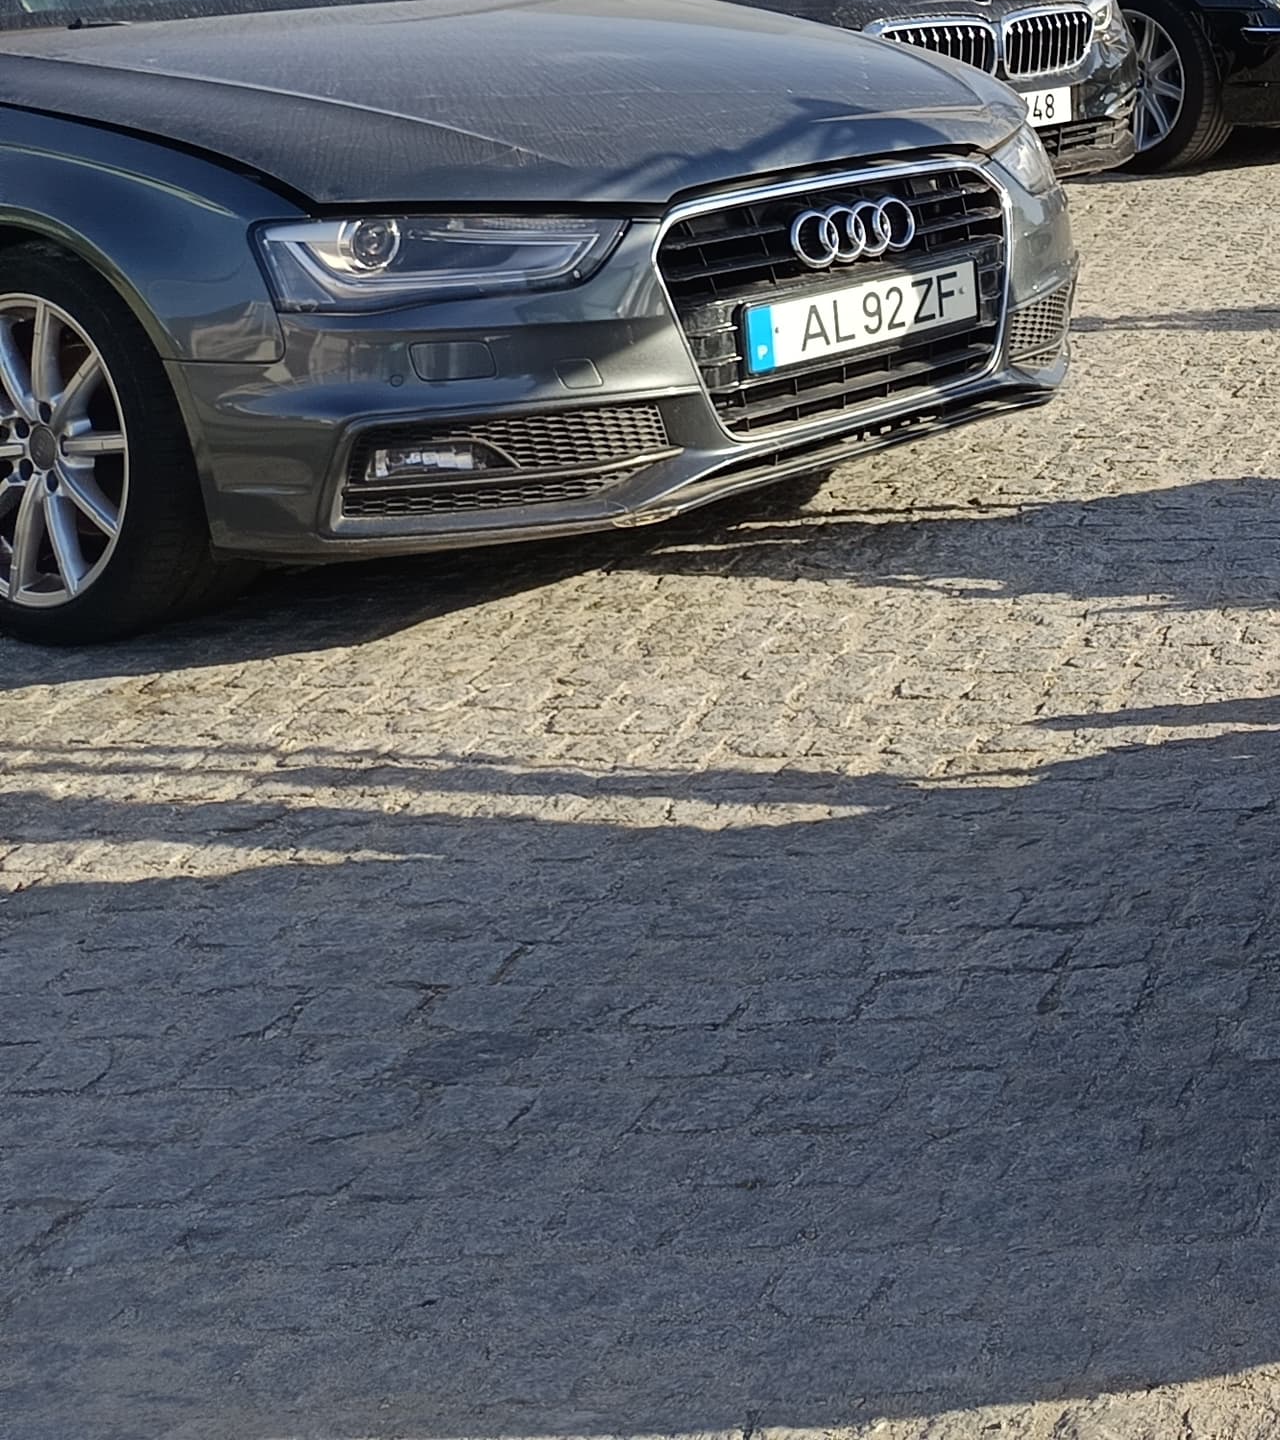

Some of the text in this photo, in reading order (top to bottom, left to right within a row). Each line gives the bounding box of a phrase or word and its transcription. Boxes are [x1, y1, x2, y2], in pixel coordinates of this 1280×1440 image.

[801, 271, 958, 353] AL 92 ZF
